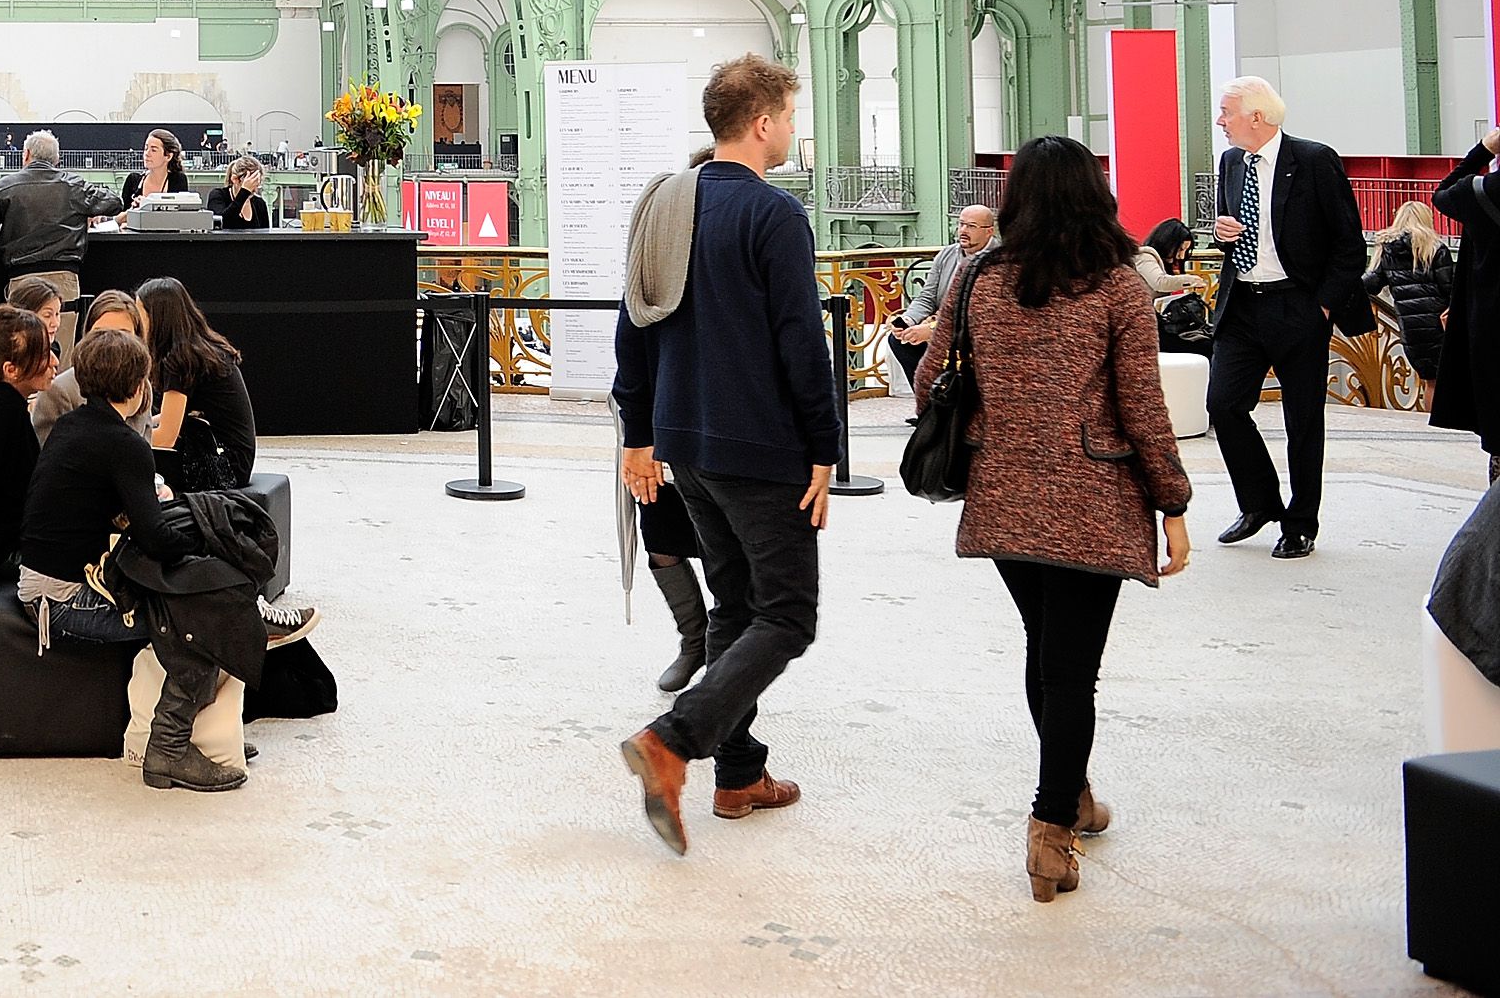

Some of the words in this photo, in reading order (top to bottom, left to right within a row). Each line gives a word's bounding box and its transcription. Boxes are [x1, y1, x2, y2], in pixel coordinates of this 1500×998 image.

[558, 69, 597, 84] MENU
[425, 190, 451, 201] NIVEAU
[426, 217, 450, 228] LEVEL
